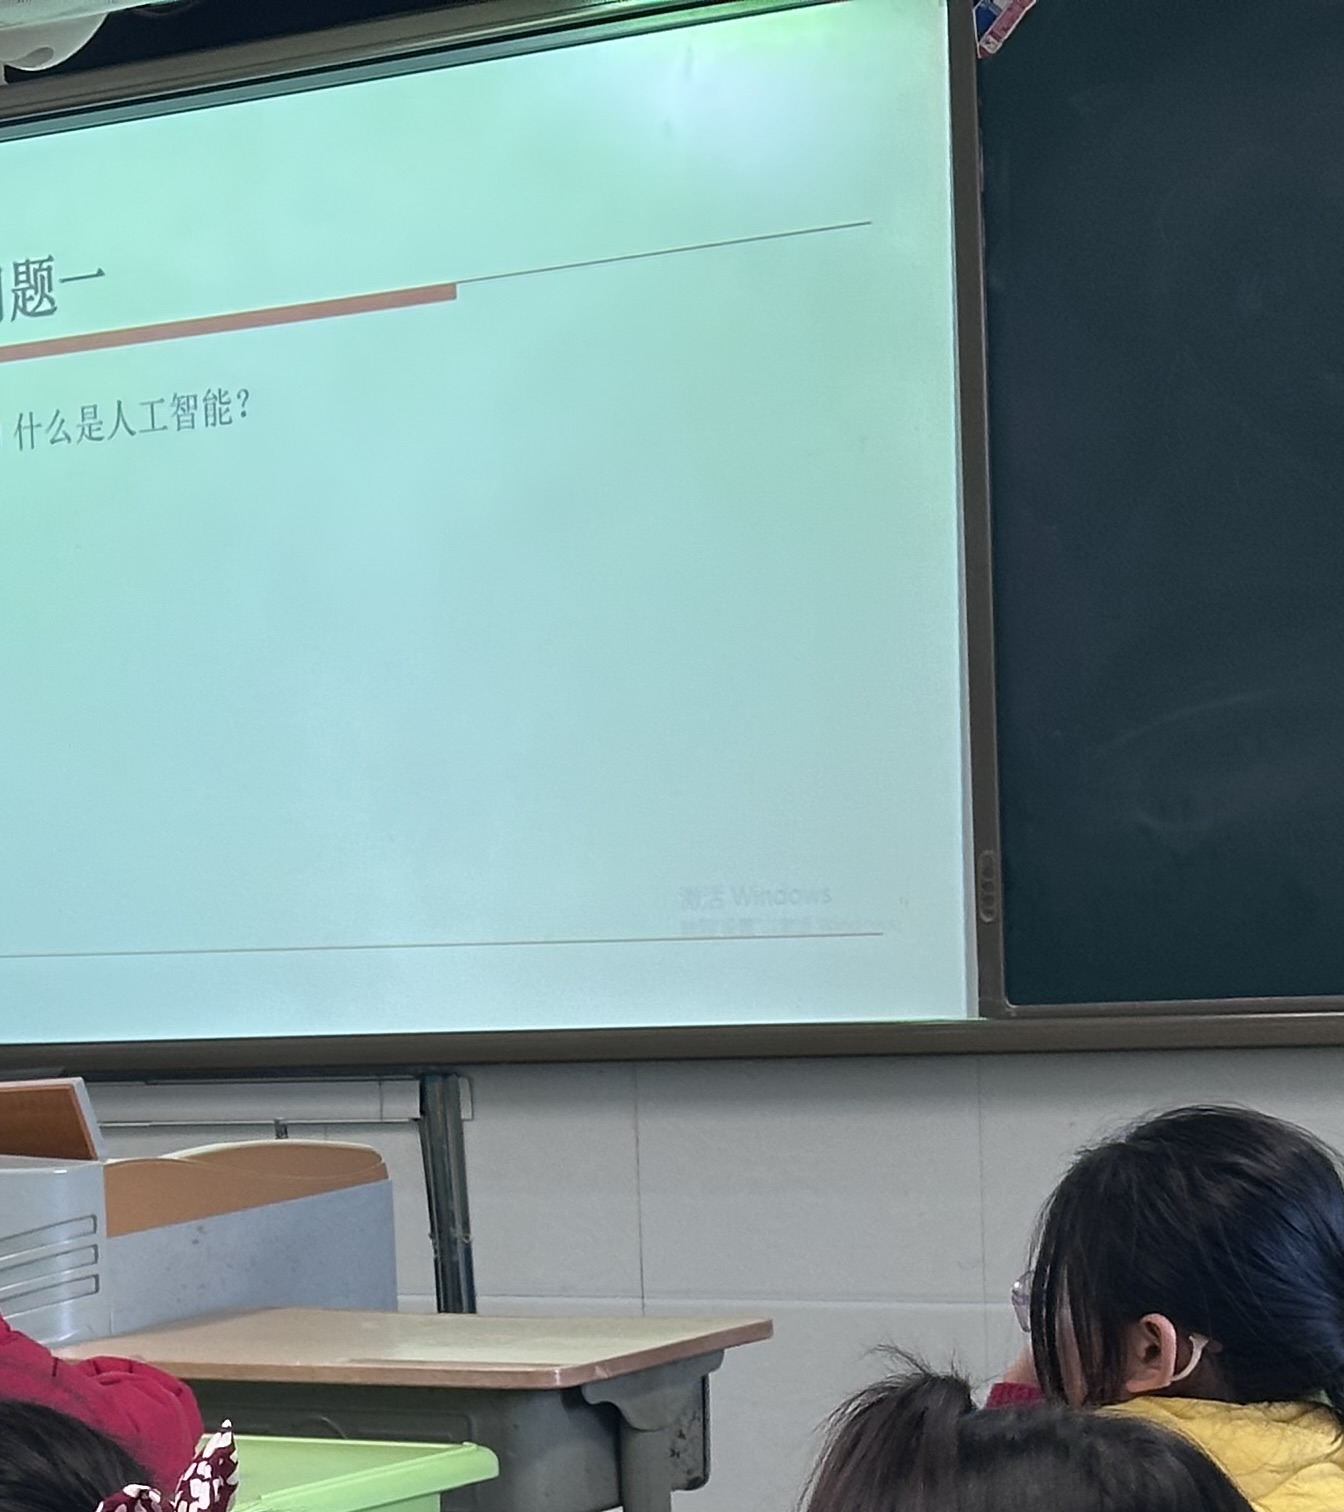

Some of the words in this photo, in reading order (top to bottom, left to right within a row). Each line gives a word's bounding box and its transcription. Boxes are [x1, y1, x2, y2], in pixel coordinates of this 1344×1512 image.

[13, 388, 251, 451] 什么是人工智能？
[731, 885, 833, 907] Windows
